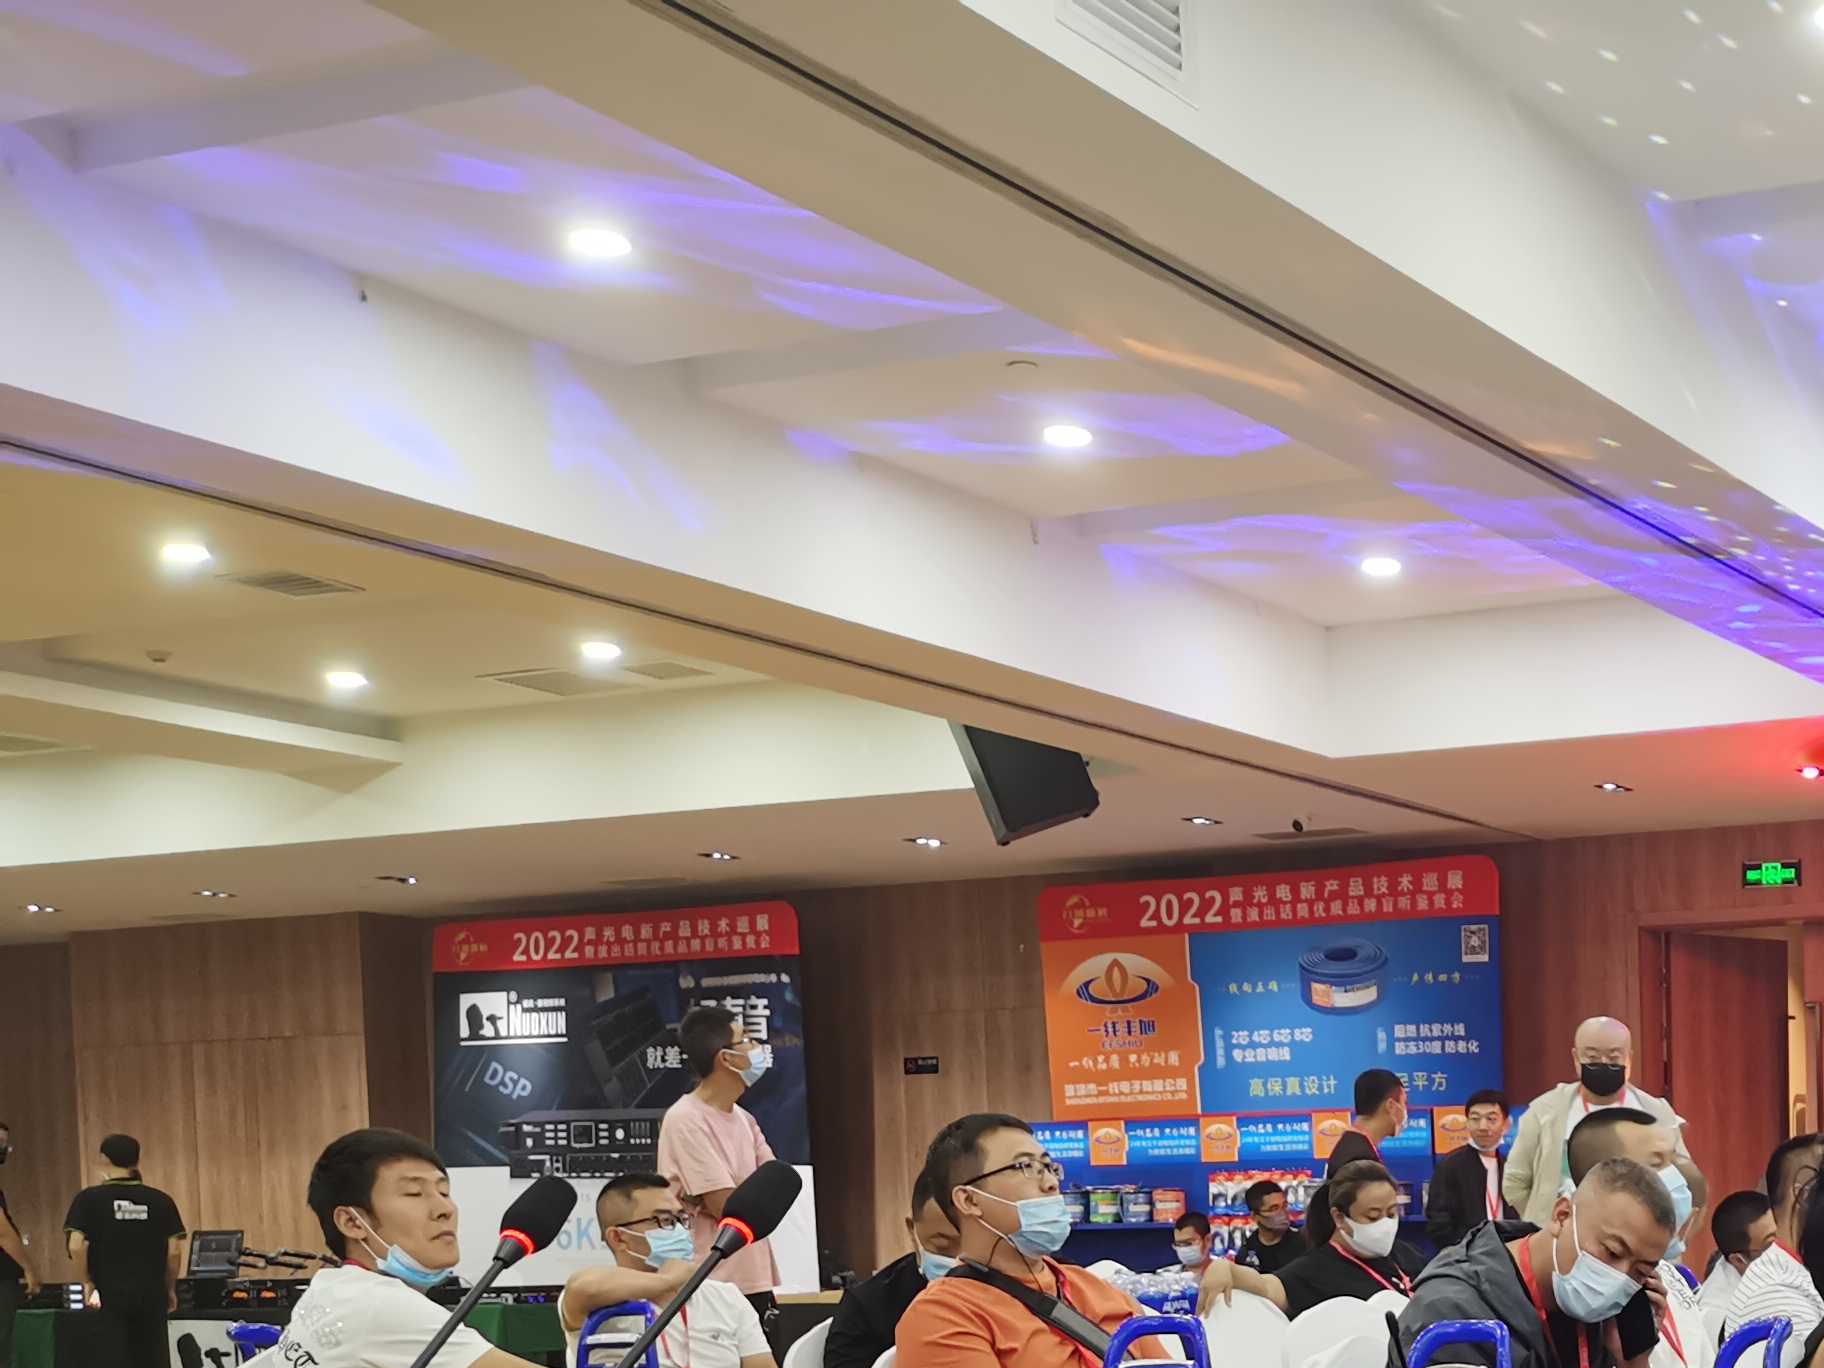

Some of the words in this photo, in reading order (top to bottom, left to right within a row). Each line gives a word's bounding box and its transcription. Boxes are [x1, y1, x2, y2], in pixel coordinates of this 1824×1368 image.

[1139, 890, 1223, 927] 2022
[513, 930, 580, 961] 2022
[1231, 1030, 1250, 1045] 2芯
[1252, 1029, 1271, 1044] 4芯
[1273, 1028, 1292, 1042] 6芯
[1294, 1027, 1313, 1042] 8芯
[1444, 1038, 1480, 1053] 防老化
[1232, 1046, 1291, 1063] 专业音响线
[483, 1061, 533, 1100] DSP
[1249, 1075, 1338, 1096] 高保真设计
